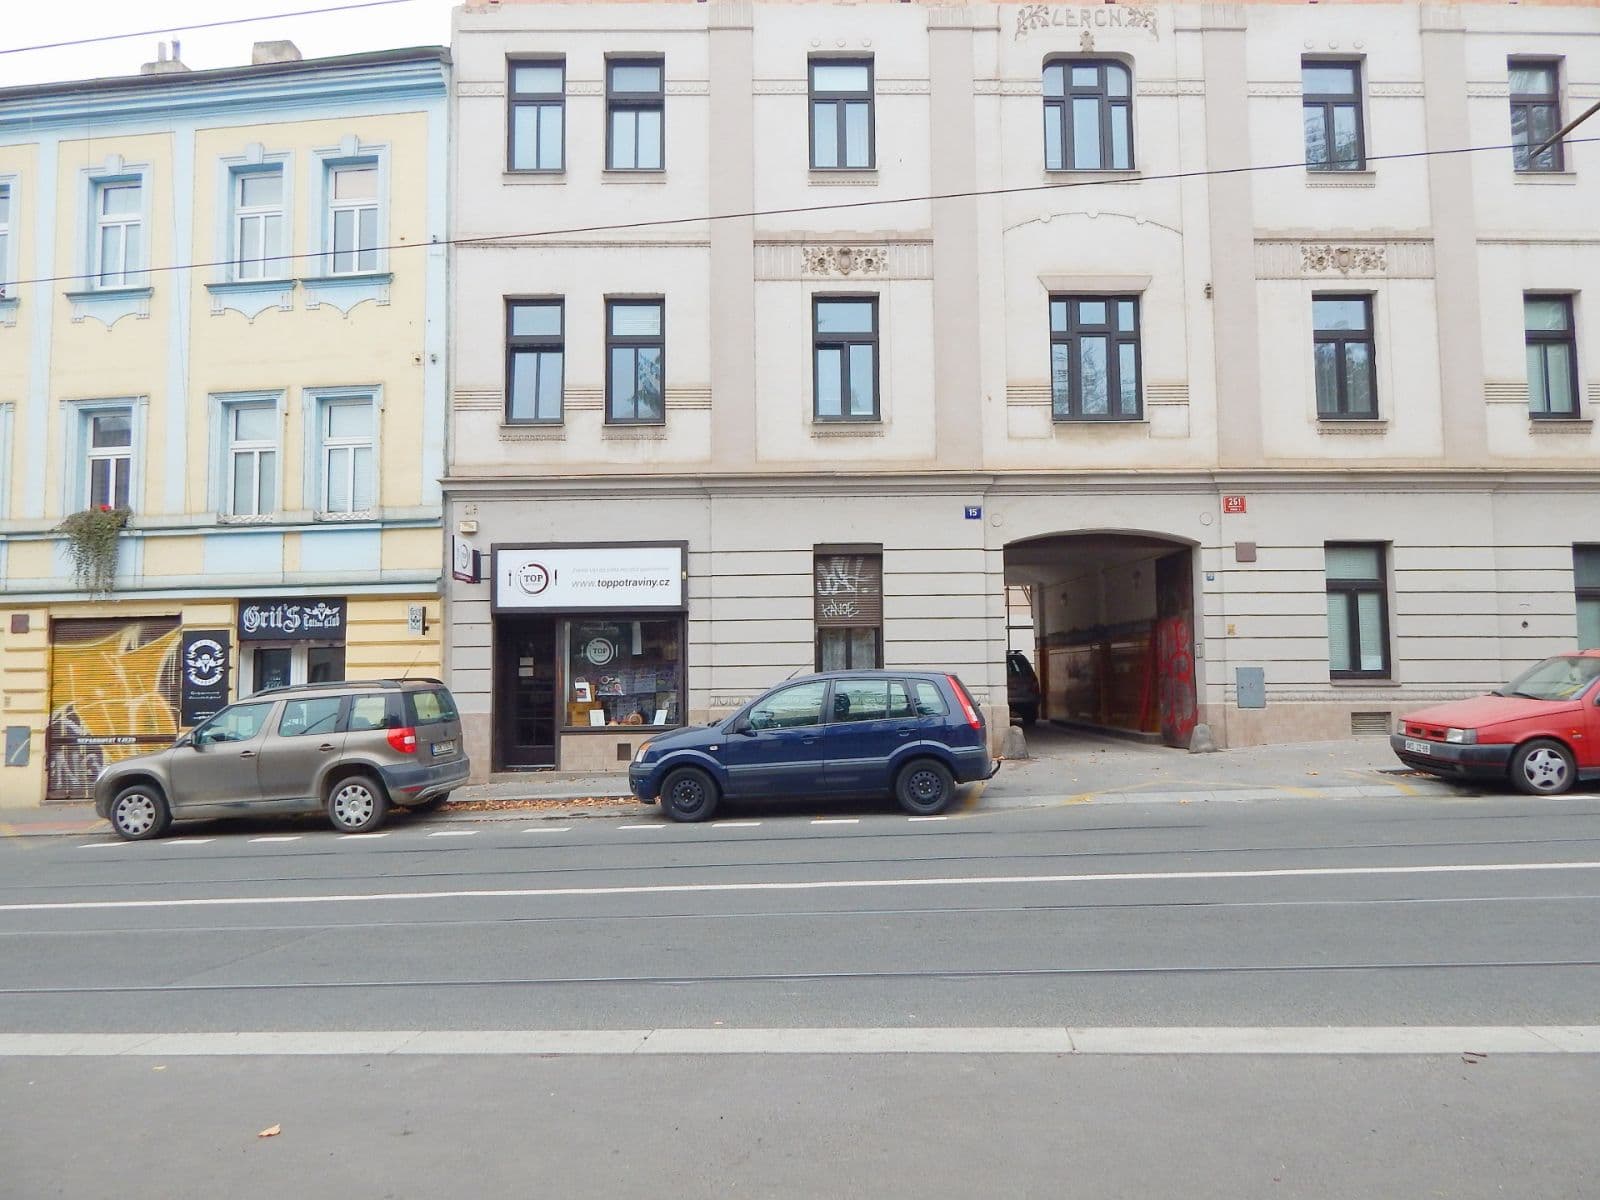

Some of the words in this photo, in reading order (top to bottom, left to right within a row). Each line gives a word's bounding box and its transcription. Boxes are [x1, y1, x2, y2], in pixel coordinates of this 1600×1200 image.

[969, 508, 977, 517] 15
[523, 574, 544, 583] TOP
[571, 577, 671, 589] www.toppotraviny.cz
